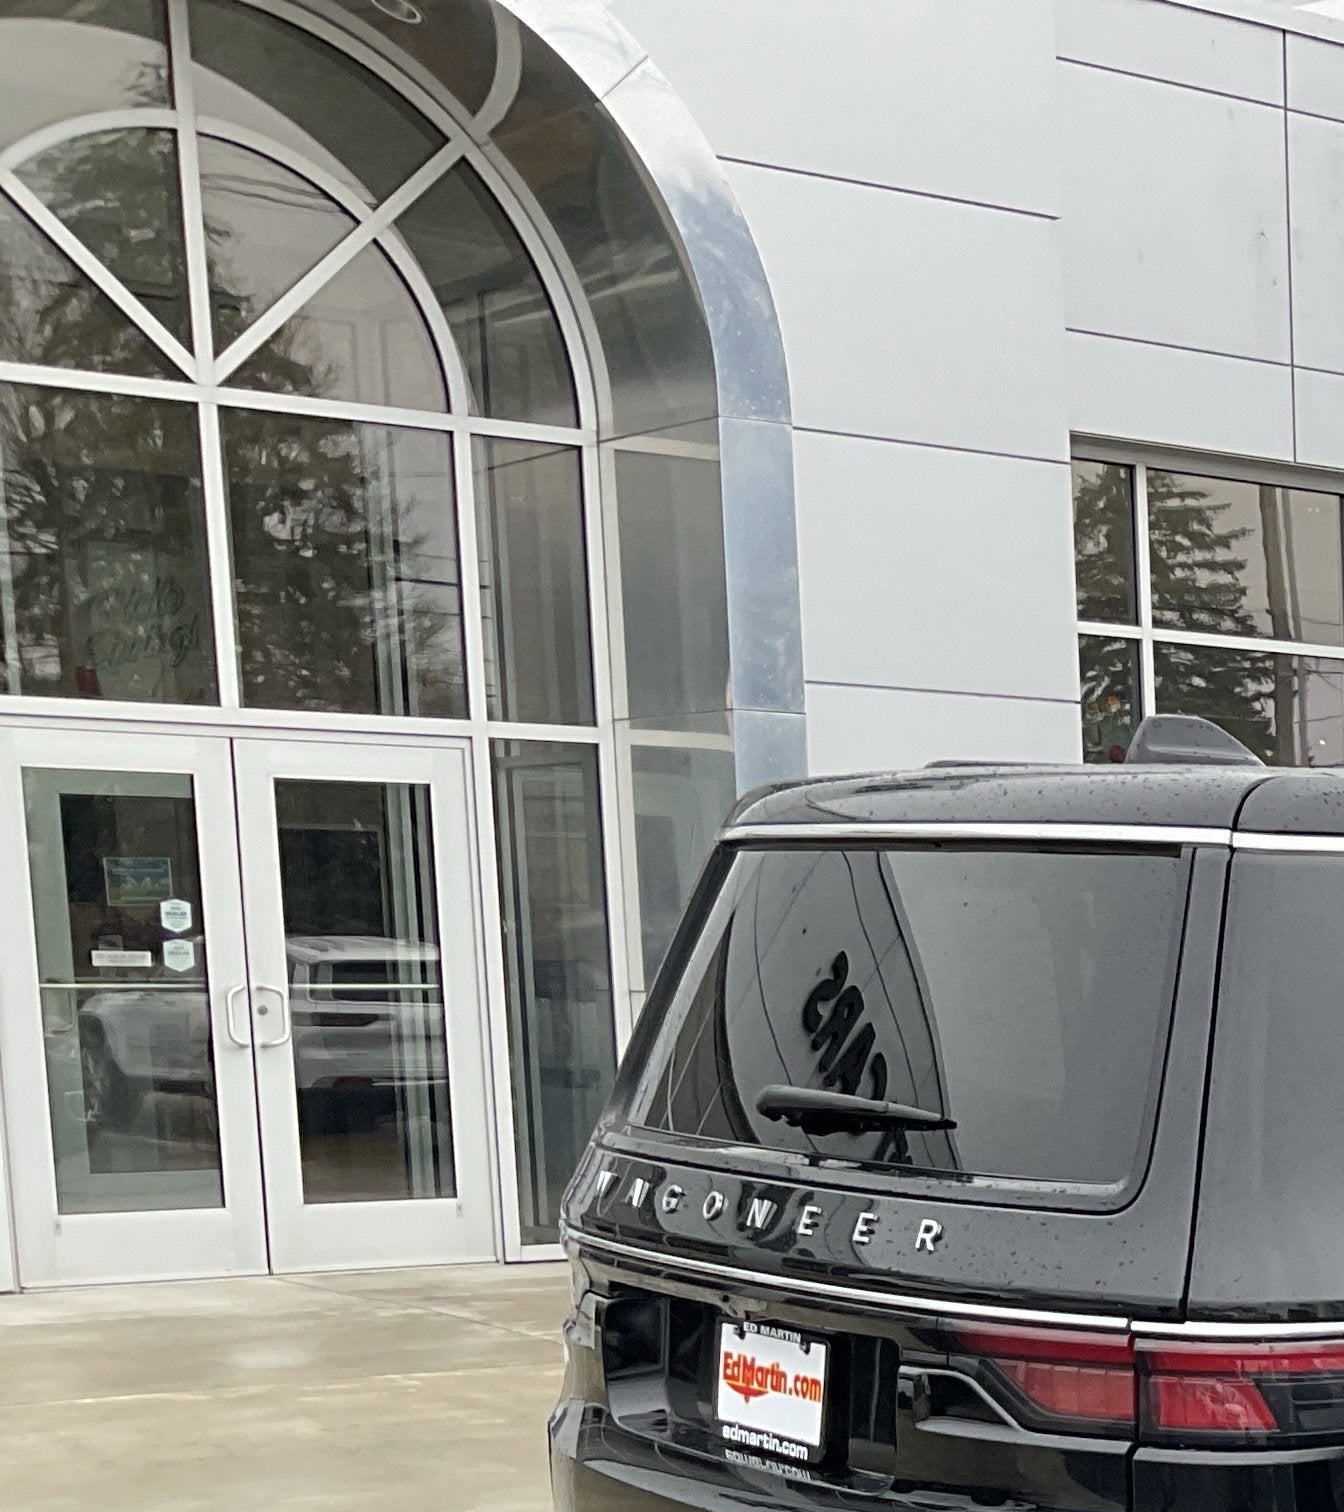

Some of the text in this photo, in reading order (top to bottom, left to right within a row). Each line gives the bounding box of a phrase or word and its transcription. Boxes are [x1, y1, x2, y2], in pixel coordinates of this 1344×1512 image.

[743, 1322, 802, 1344] ED MARTIN
[722, 1350, 823, 1403] EdMartin.com
[721, 1423, 809, 1461] edmartin.com
